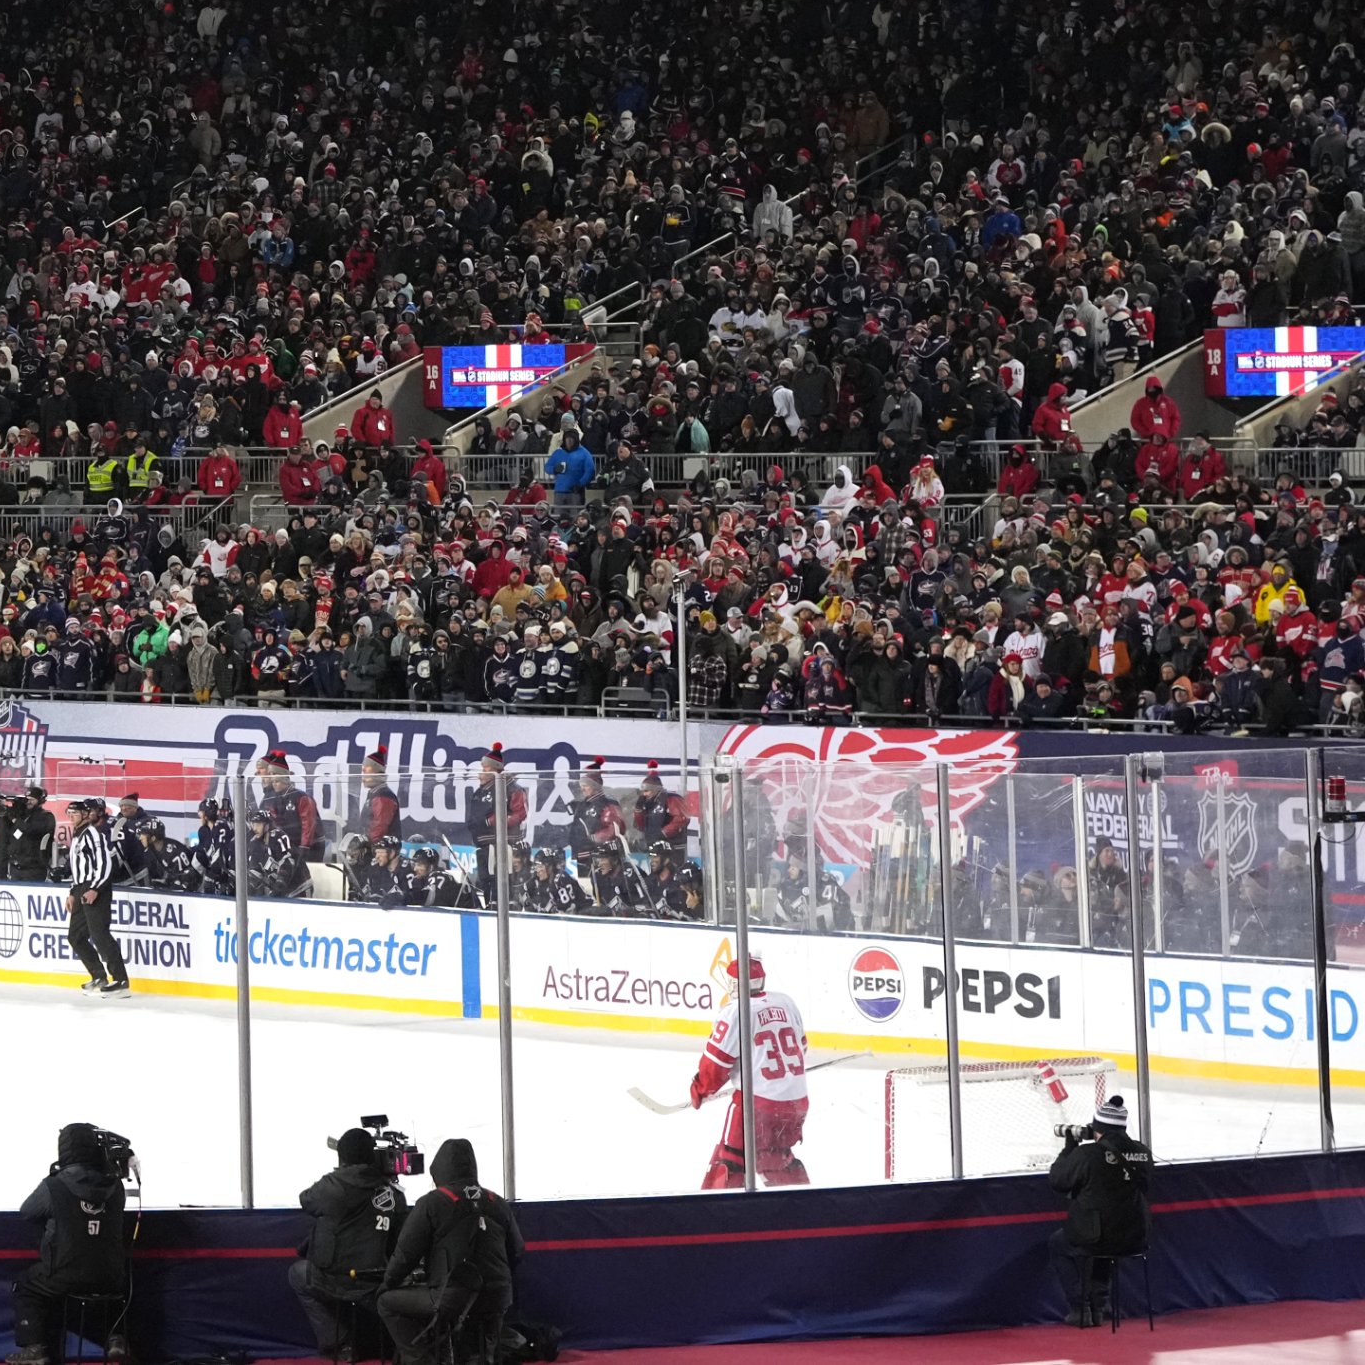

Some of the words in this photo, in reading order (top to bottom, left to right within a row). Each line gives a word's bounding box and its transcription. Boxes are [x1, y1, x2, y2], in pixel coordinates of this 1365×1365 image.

[1207, 349, 1221, 365] 18
[426, 365, 438, 379] 16
[1210, 365, 1218, 375] A
[429, 380, 436, 389] A
[277, 835, 291, 852] 17
[172, 852, 190, 872] 78
[427, 872, 445, 888] 27
[557, 884, 575, 904] 82
[27, 894, 68, 922] NAV
[109, 898, 190, 930] EDERAL
[214, 917, 437, 977] ticketmaster
[542, 965, 713, 1011] AstraZeneca
[853, 976, 902, 994] PEPSI
[922, 965, 1061, 1020] PEPSI
[709, 1020, 730, 1044] 9
[754, 1026, 805, 1081] 39
[375, 1215, 391, 1232] 29
